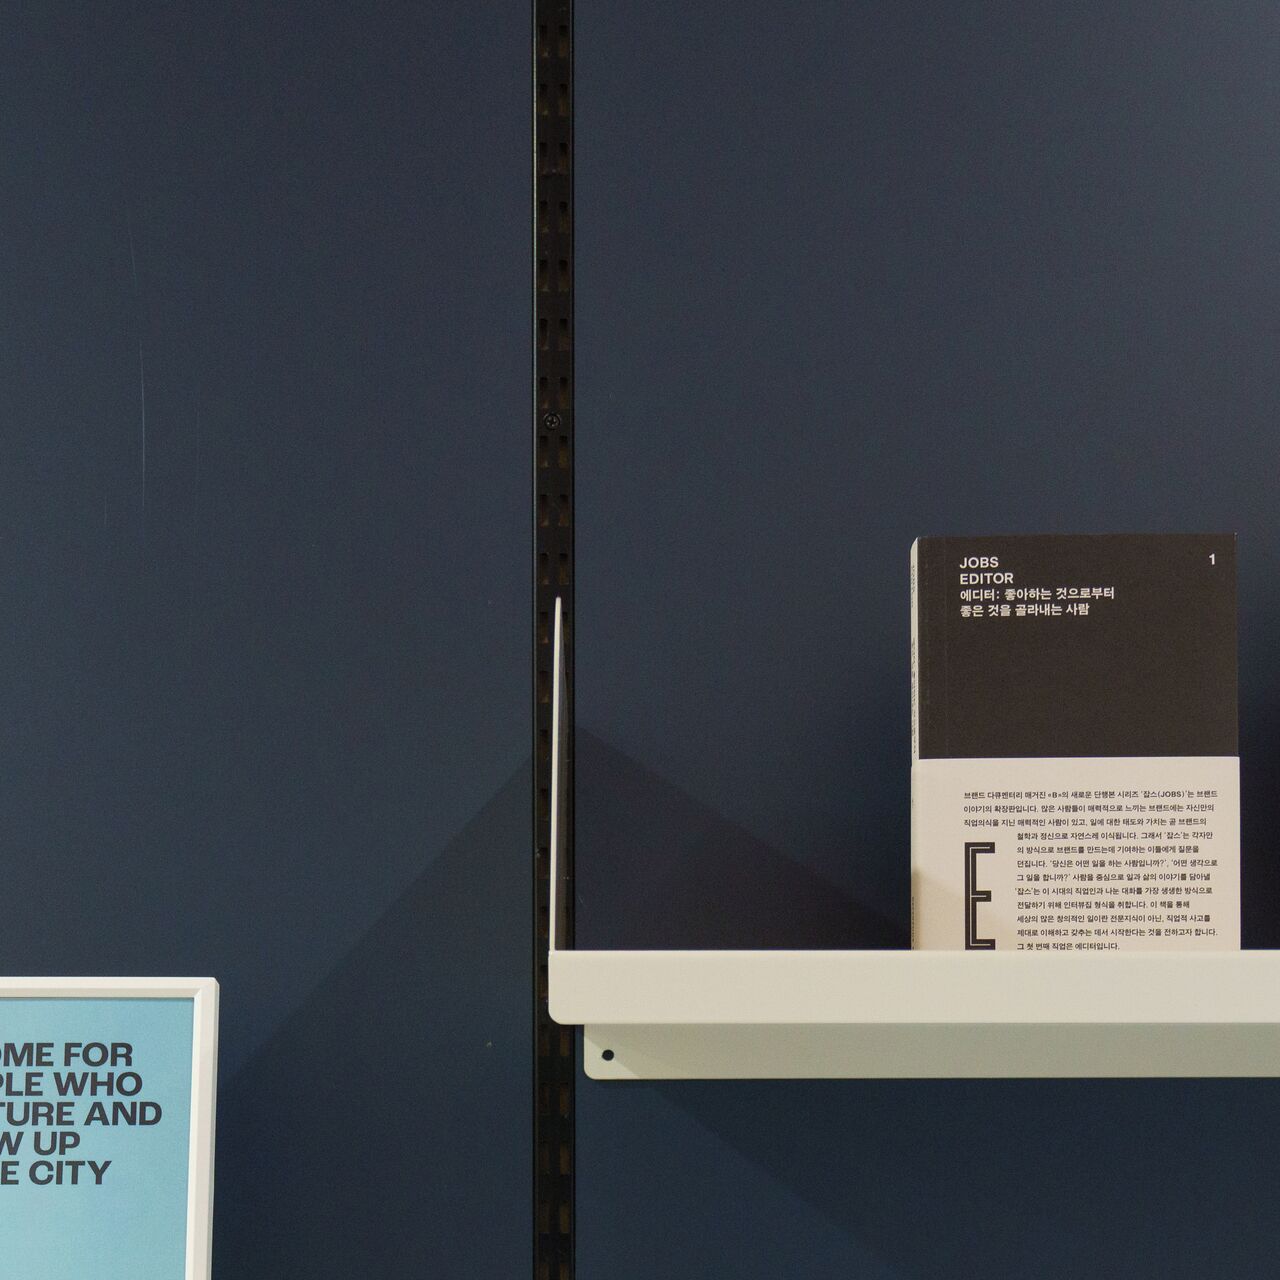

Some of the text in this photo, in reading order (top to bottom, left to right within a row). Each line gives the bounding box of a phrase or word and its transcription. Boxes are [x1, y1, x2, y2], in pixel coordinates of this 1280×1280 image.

[960, 557, 998, 568] JOBS
[1208, 553, 1216, 565] 1
[960, 573, 1013, 584] EDITOR
[960, 587, 1114, 601] 에디터: 좋아하는 것으로부터
[960, 603, 1089, 617] 좋은 것을 골라내는 사람
[64, 1042, 132, 1067] FOR
[53, 1072, 142, 1096] WHO
[84, 1102, 162, 1125] AND
[34, 1132, 80, 1155] UP
[29, 1161, 112, 1185] CITY
